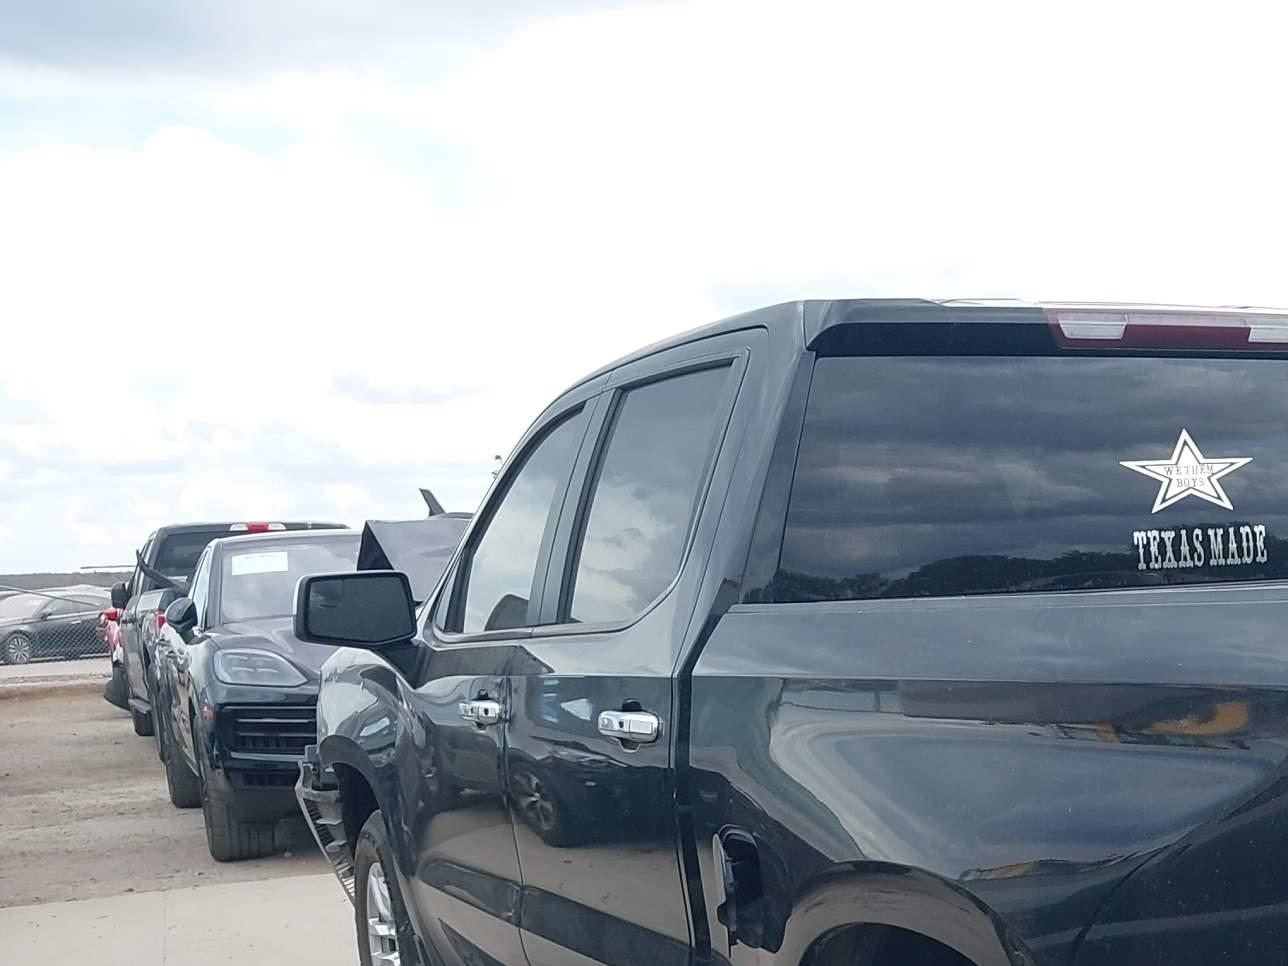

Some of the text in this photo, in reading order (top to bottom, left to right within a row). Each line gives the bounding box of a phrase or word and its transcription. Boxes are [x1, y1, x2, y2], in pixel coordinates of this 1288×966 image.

[1164, 464, 1213, 475] WE THEM
[1176, 478, 1205, 487] BOYS
[1133, 524, 1268, 570] TEXAS MADE
